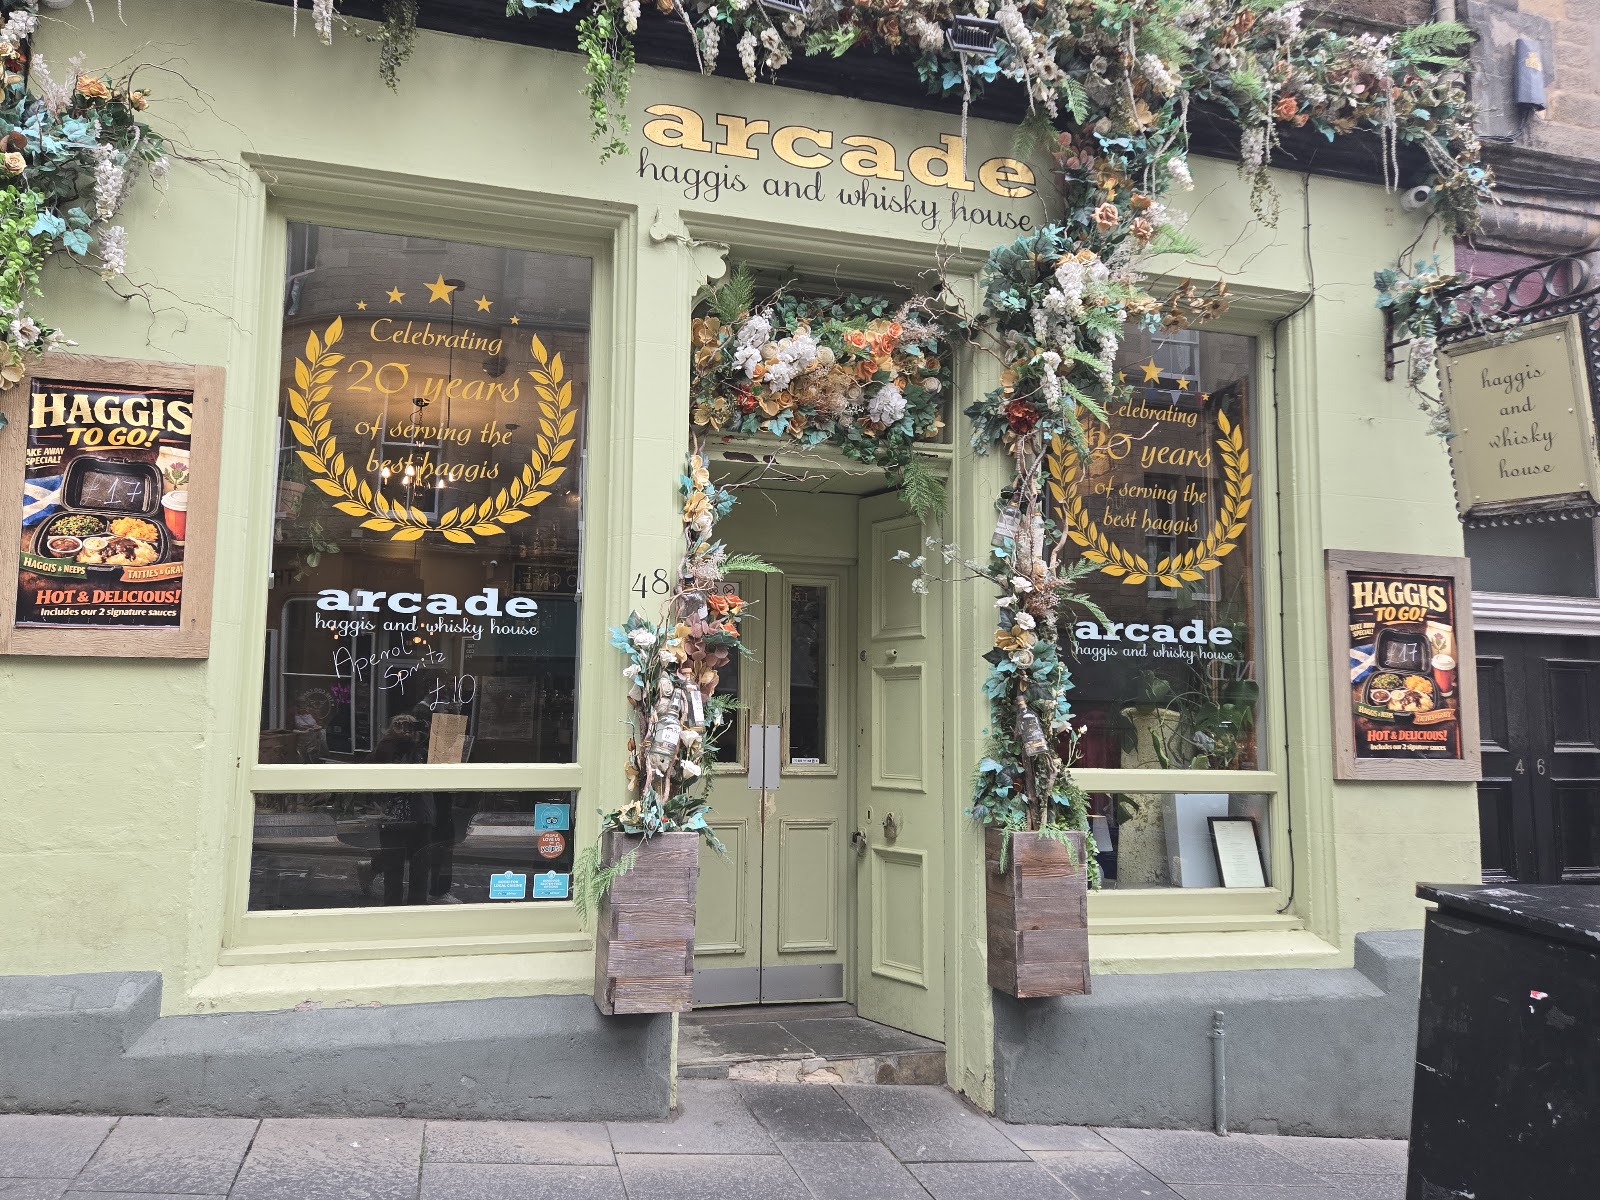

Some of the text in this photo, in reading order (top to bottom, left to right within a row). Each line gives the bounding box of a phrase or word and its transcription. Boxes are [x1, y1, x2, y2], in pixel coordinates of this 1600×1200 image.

[642, 103, 1036, 198] arcade
[636, 147, 1034, 232] haggis and whisky house
[370, 318, 503, 356] Celebrating
[346, 360, 521, 403] 20 years
[1481, 364, 1545, 394] haggis
[29, 392, 193, 436] HAGGIS
[1104, 397, 1198, 428] Celebrating
[1500, 396, 1536, 416] and
[66, 427, 160, 448] TO GO!
[354, 412, 513, 448] of serving the
[1488, 421, 1558, 451] whisky
[27, 447, 65, 456] AKE AWAY
[366, 448, 499, 483] best haggis
[1141, 445, 1212, 469] years
[1499, 458, 1555, 479] house
[78, 477, 142, 506] £17
[1094, 475, 1207, 506] of serving the
[1103, 505, 1198, 534] best haggis
[23, 557, 57, 572] HAGGIS
[63, 565, 86, 574] NEEPS
[127, 569, 159, 579] TATTIES
[35, 589, 181, 605] HOT & DELICIOUS!
[631, 568, 670, 599] 48
[1351, 580, 1447, 613] HAGGIS
[41, 607, 79, 616] Includes
[98, 608, 106, 616] 2
[106, 608, 147, 618] signature
[147, 609, 177, 617] sauces
[316, 587, 538, 618] arcade
[1374, 606, 1427, 622] TO GO!
[315, 612, 539, 640] haggis and whisky house
[1074, 619, 1233, 645] arcade
[332, 632, 413, 681] Aperol
[1075, 643, 1235, 666] haggis and whisky house
[1384, 642, 1418, 666] £17
[378, 644, 446, 695] Spritz
[429, 674, 476, 711] £10
[1367, 730, 1448, 742] HOT & DELICIOUS!
